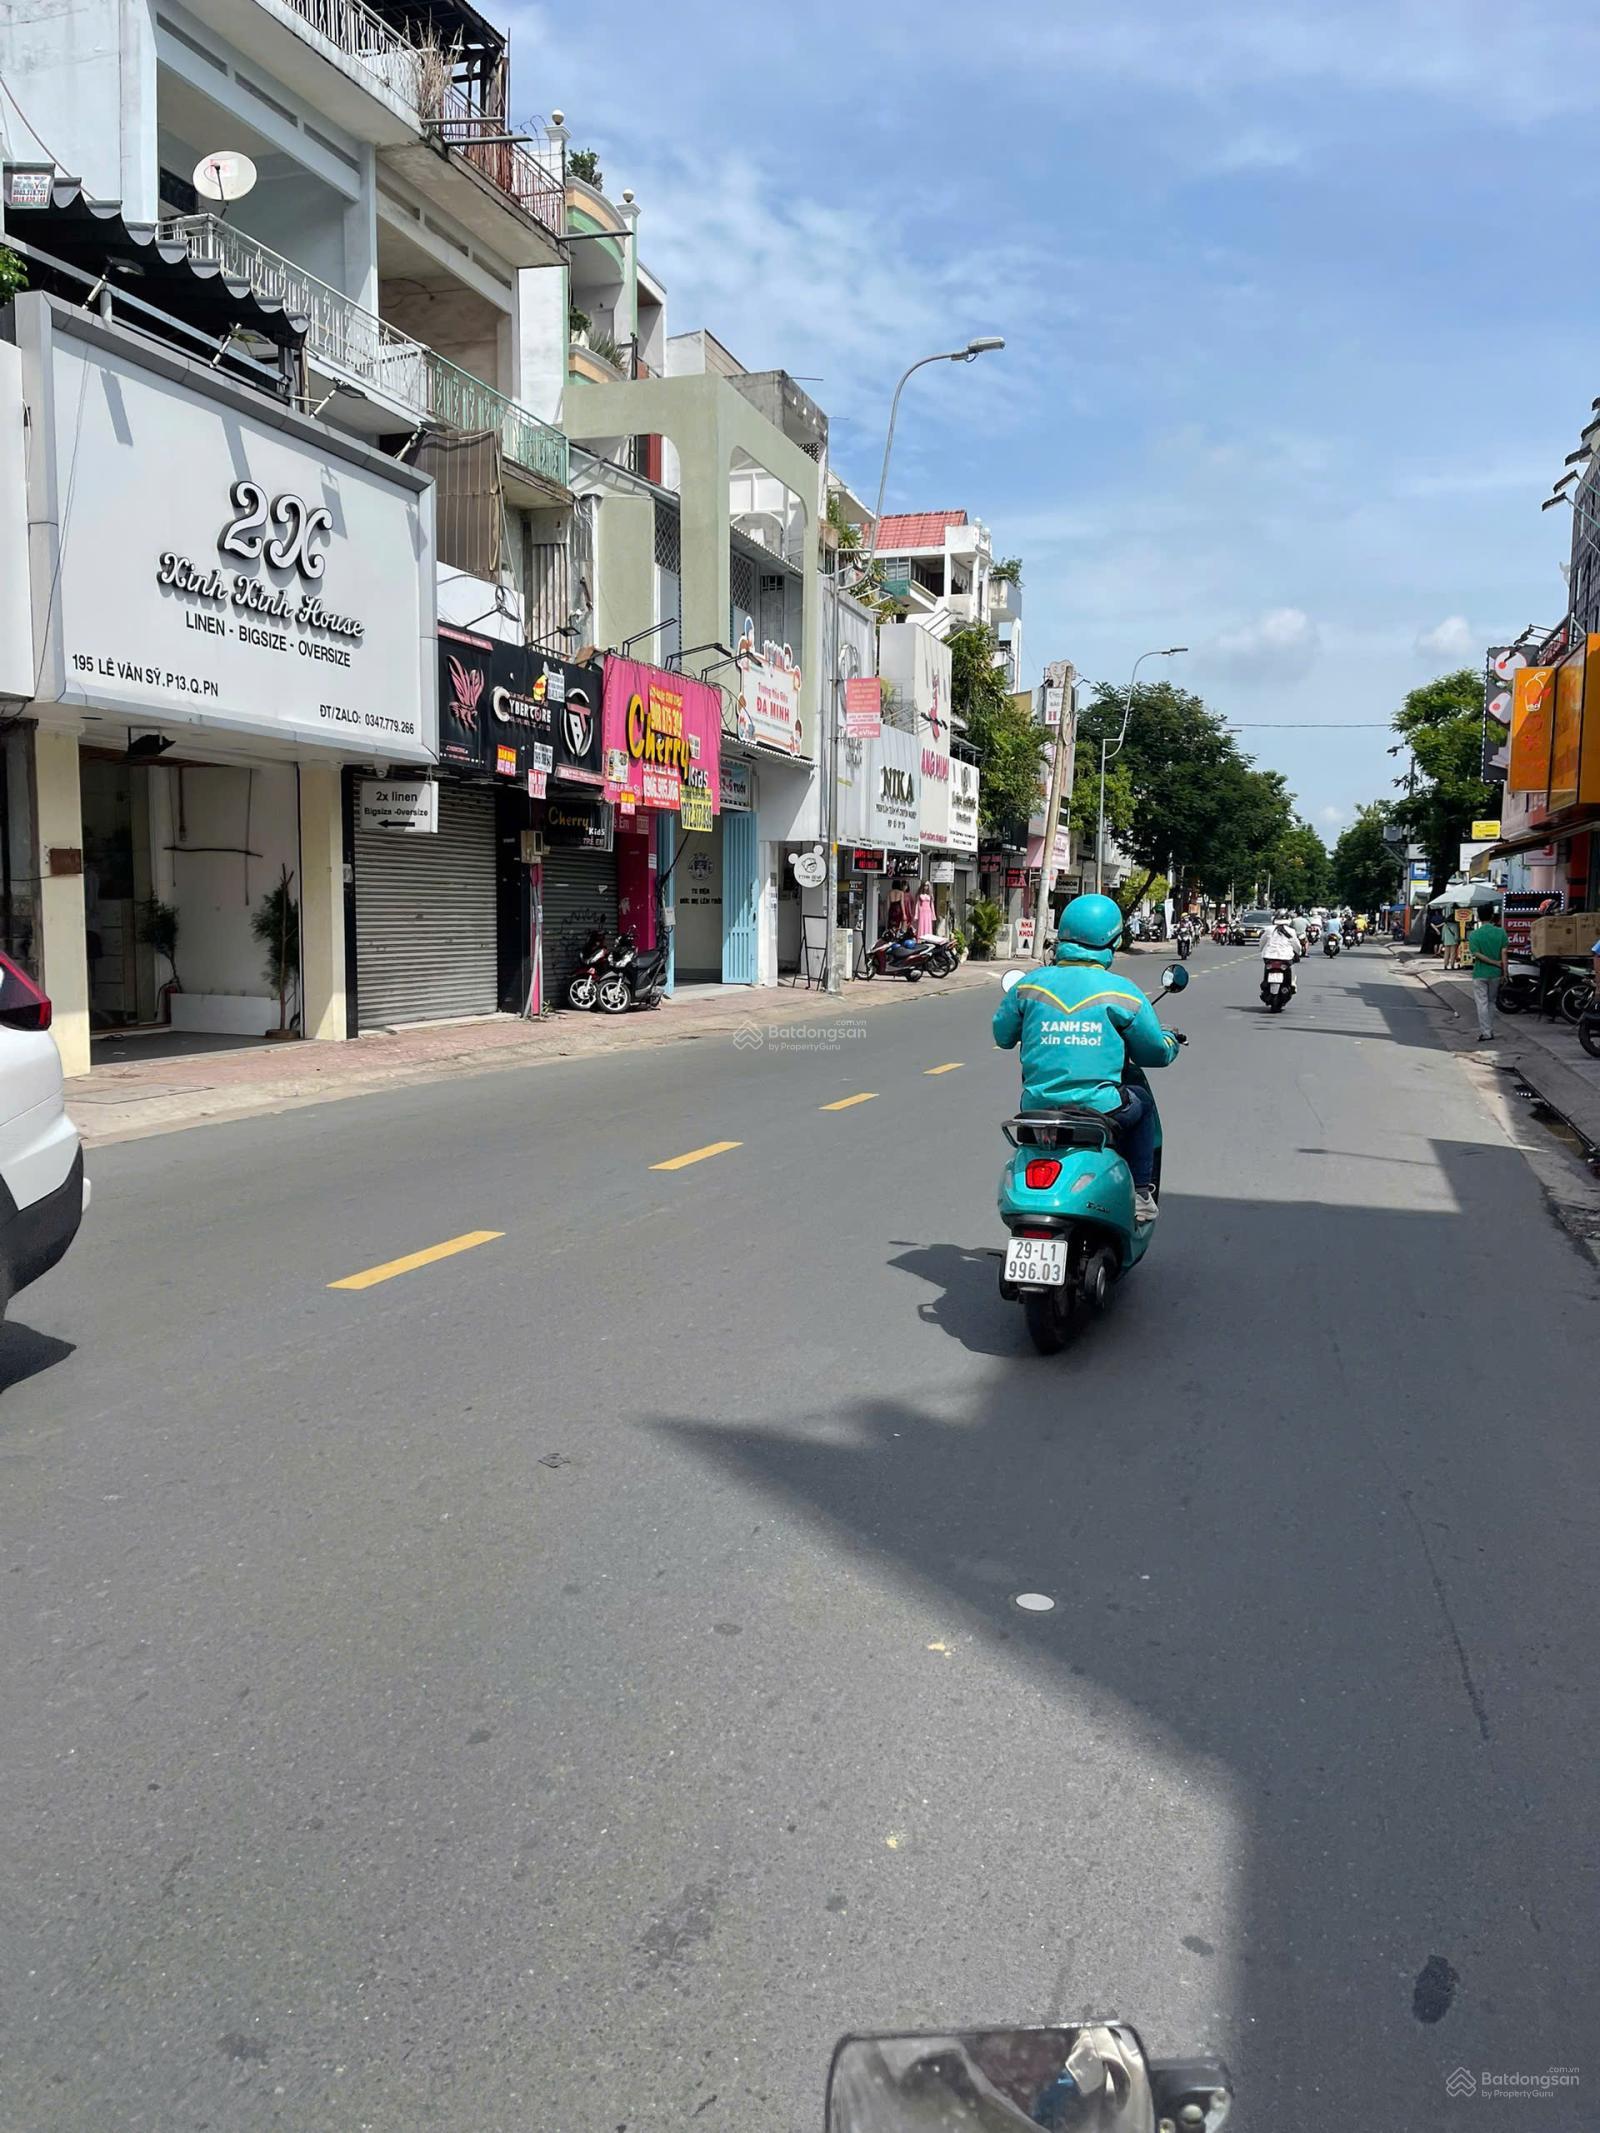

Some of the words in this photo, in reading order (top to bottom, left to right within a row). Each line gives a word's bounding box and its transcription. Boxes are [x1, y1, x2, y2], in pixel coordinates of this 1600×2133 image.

[218, 481, 333, 579] 2X
[157, 552, 228, 600] Xinh
[232, 575, 294, 618] Xinh
[296, 595, 365, 637] House
[186, 611, 225, 636] LINEN
[239, 625, 287, 651] BIGSIZE
[298, 640, 351, 667] OVERSIZE
[72, 653, 94, 672] 195
[98, 657, 115, 677] LÊ
[117, 662, 142, 682] VĂN
[365, 713, 415, 734] 0347.779.266
[629, 694, 689, 780] Cherry
[689, 766, 709, 788] Kids
[881, 766, 914, 803] NIKA
[376, 791, 389, 801] 2x
[392, 791, 418, 802] linen
[549, 806, 589, 831] Cherry
[1040, 1034, 1060, 1045] xin
[1015, 1241, 1057, 1261] 29-L1
[1008, 1261, 1061, 1282] 996.03
